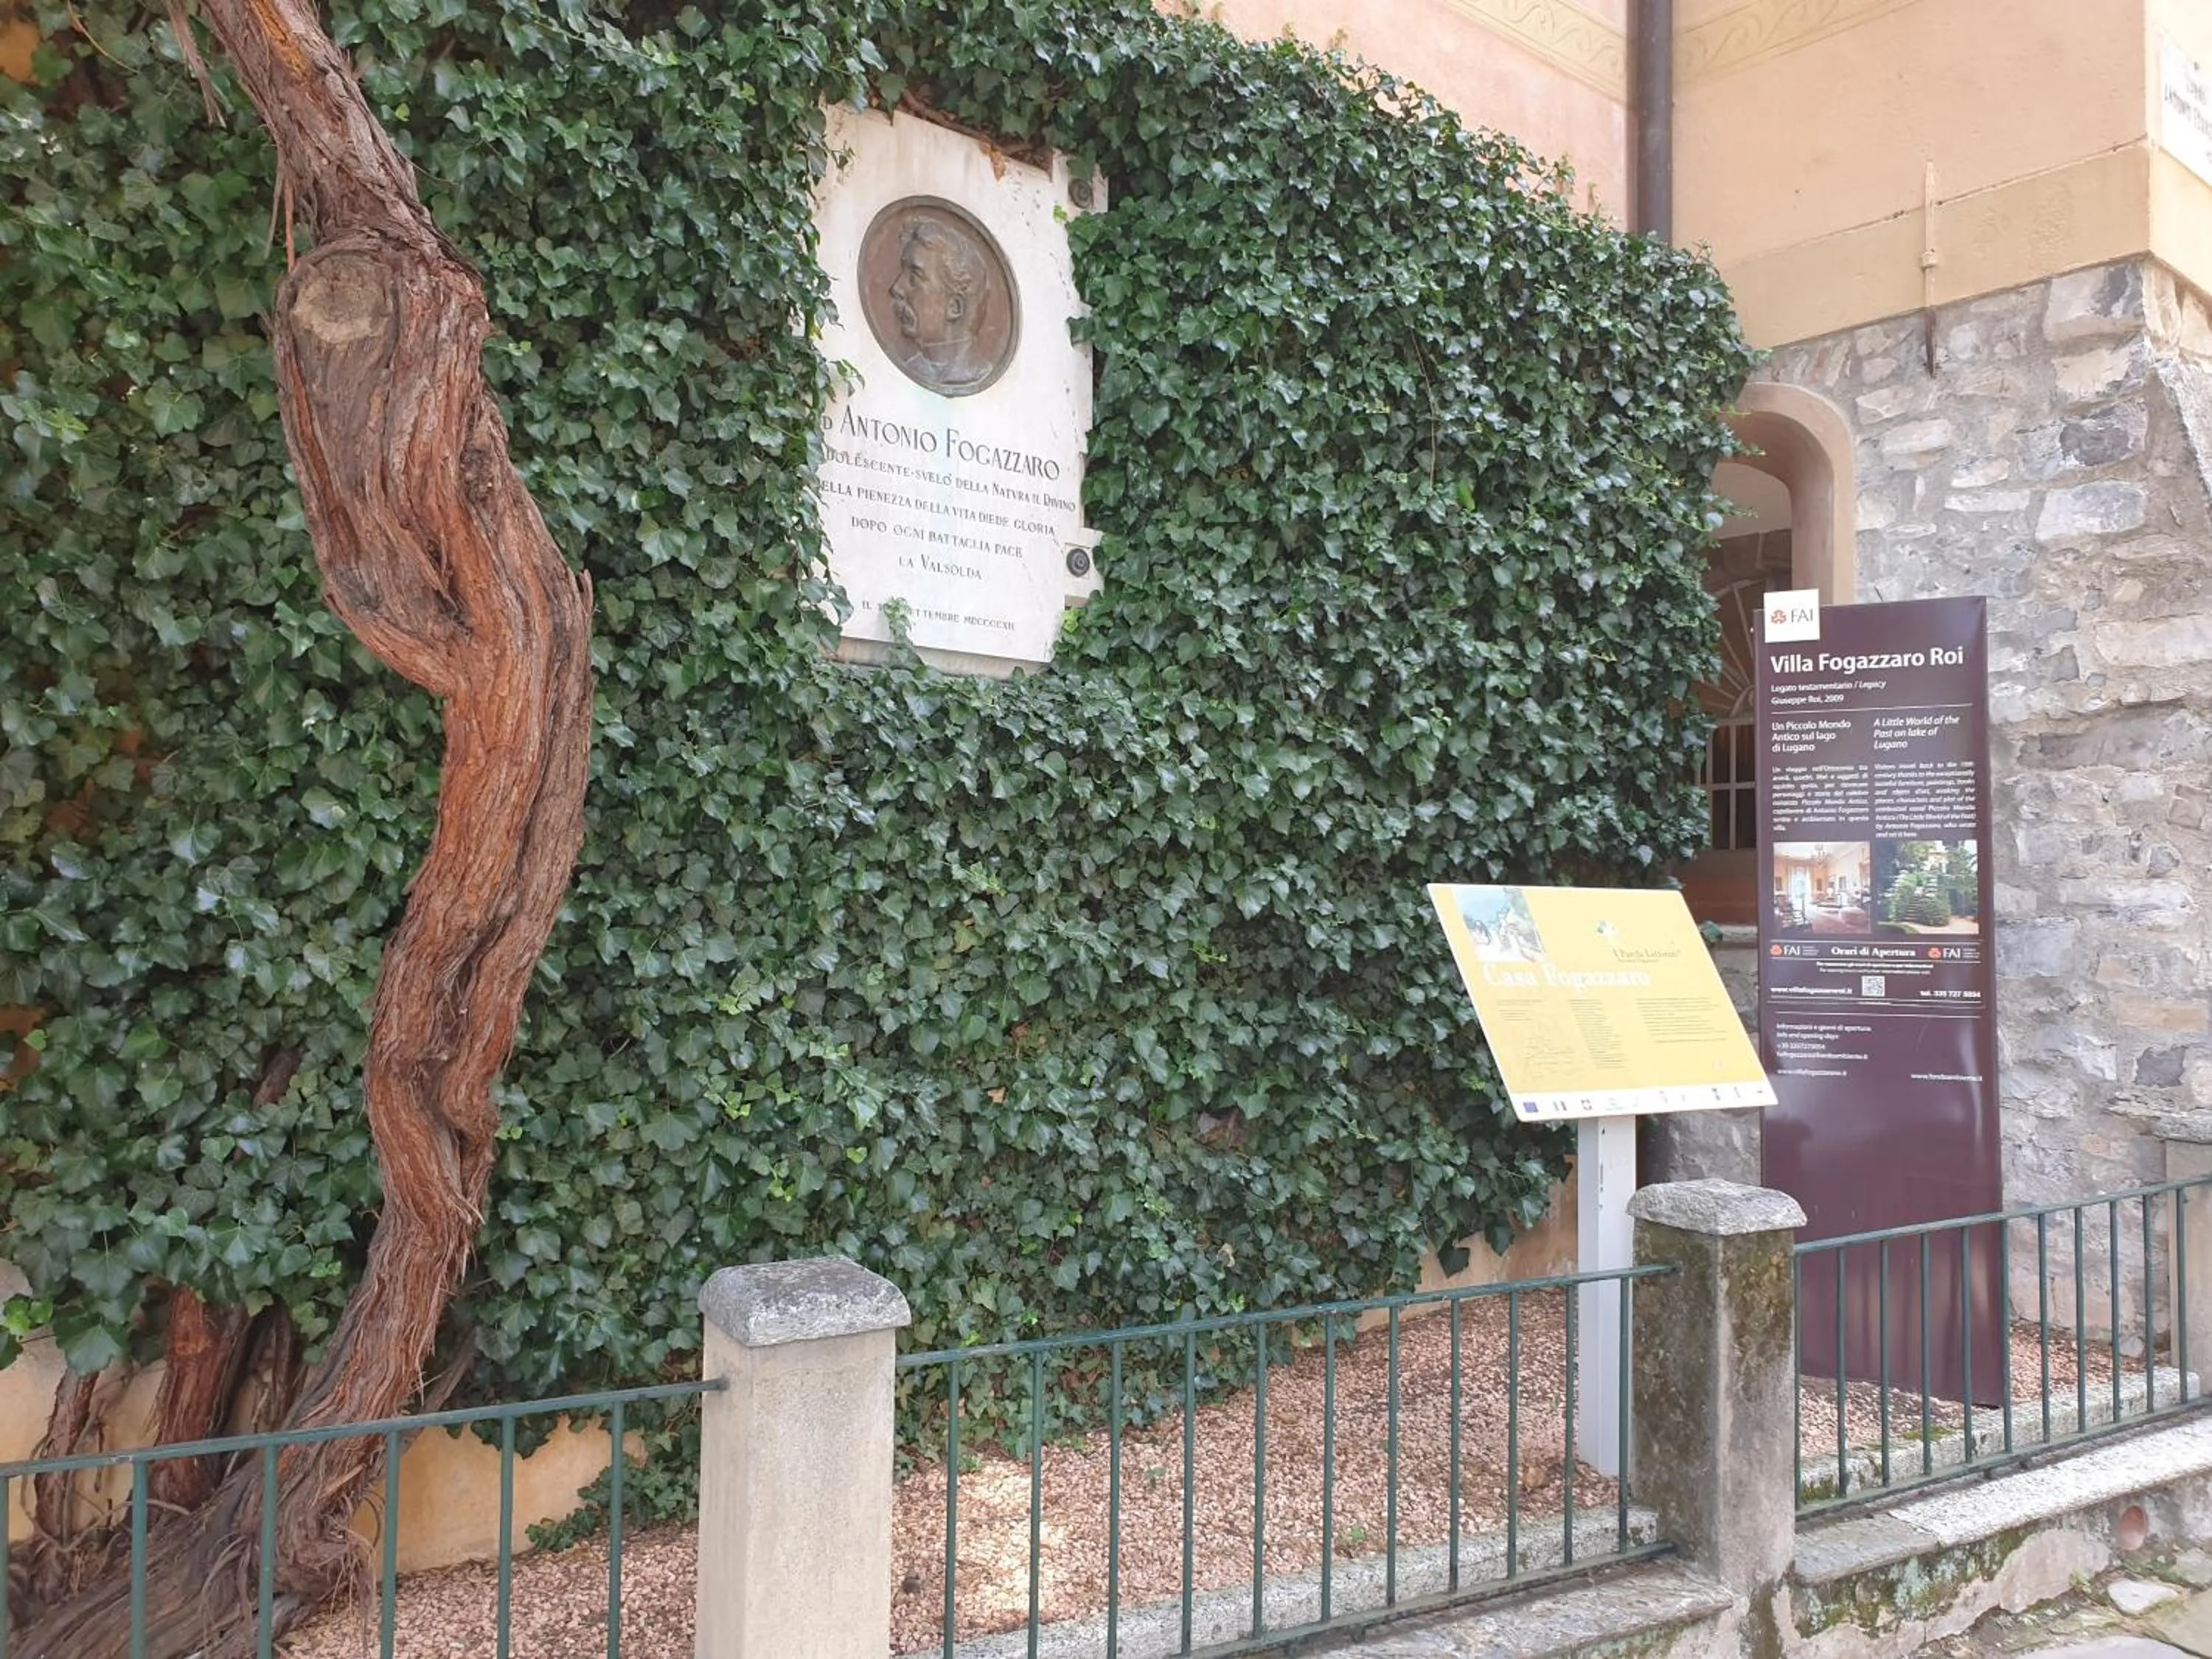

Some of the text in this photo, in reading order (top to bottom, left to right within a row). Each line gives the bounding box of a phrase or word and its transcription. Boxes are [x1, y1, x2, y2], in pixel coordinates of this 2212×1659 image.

[841, 405, 937, 453] ANTONIO
[946, 427, 1060, 481] FOGAZZARO
[956, 477, 989, 495] DELLA
[821, 480, 1056, 537] ELLA PIENEZZA DELLA VITA DIEDE GLORIA
[852, 516, 1023, 558] DOPO OGNI BATTAGLIA PACE
[898, 554, 982, 580] LA VALSOLDA
[1790, 608, 1813, 623] FAI
[1770, 646, 1964, 675] Villa Fogazzaro Roi
[1770, 684, 1797, 694] Legato
[1825, 693, 1844, 703] 2009
[1772, 720, 1851, 731] Un Piccolo Mondo
[1874, 714, 1961, 726] A Little World of the
[1772, 731, 1837, 742] Antico sul lago
[1874, 726, 1938, 738] Past on lake of
[1772, 742, 1816, 754] di Lugano
[1874, 740, 1908, 751] Lugano
[1784, 944, 1800, 956] FAI
[1831, 945, 1857, 956] Orari
[1859, 946, 1869, 956] di
[1872, 947, 1916, 959] Apertura
[1943, 947, 1961, 959] FAI
